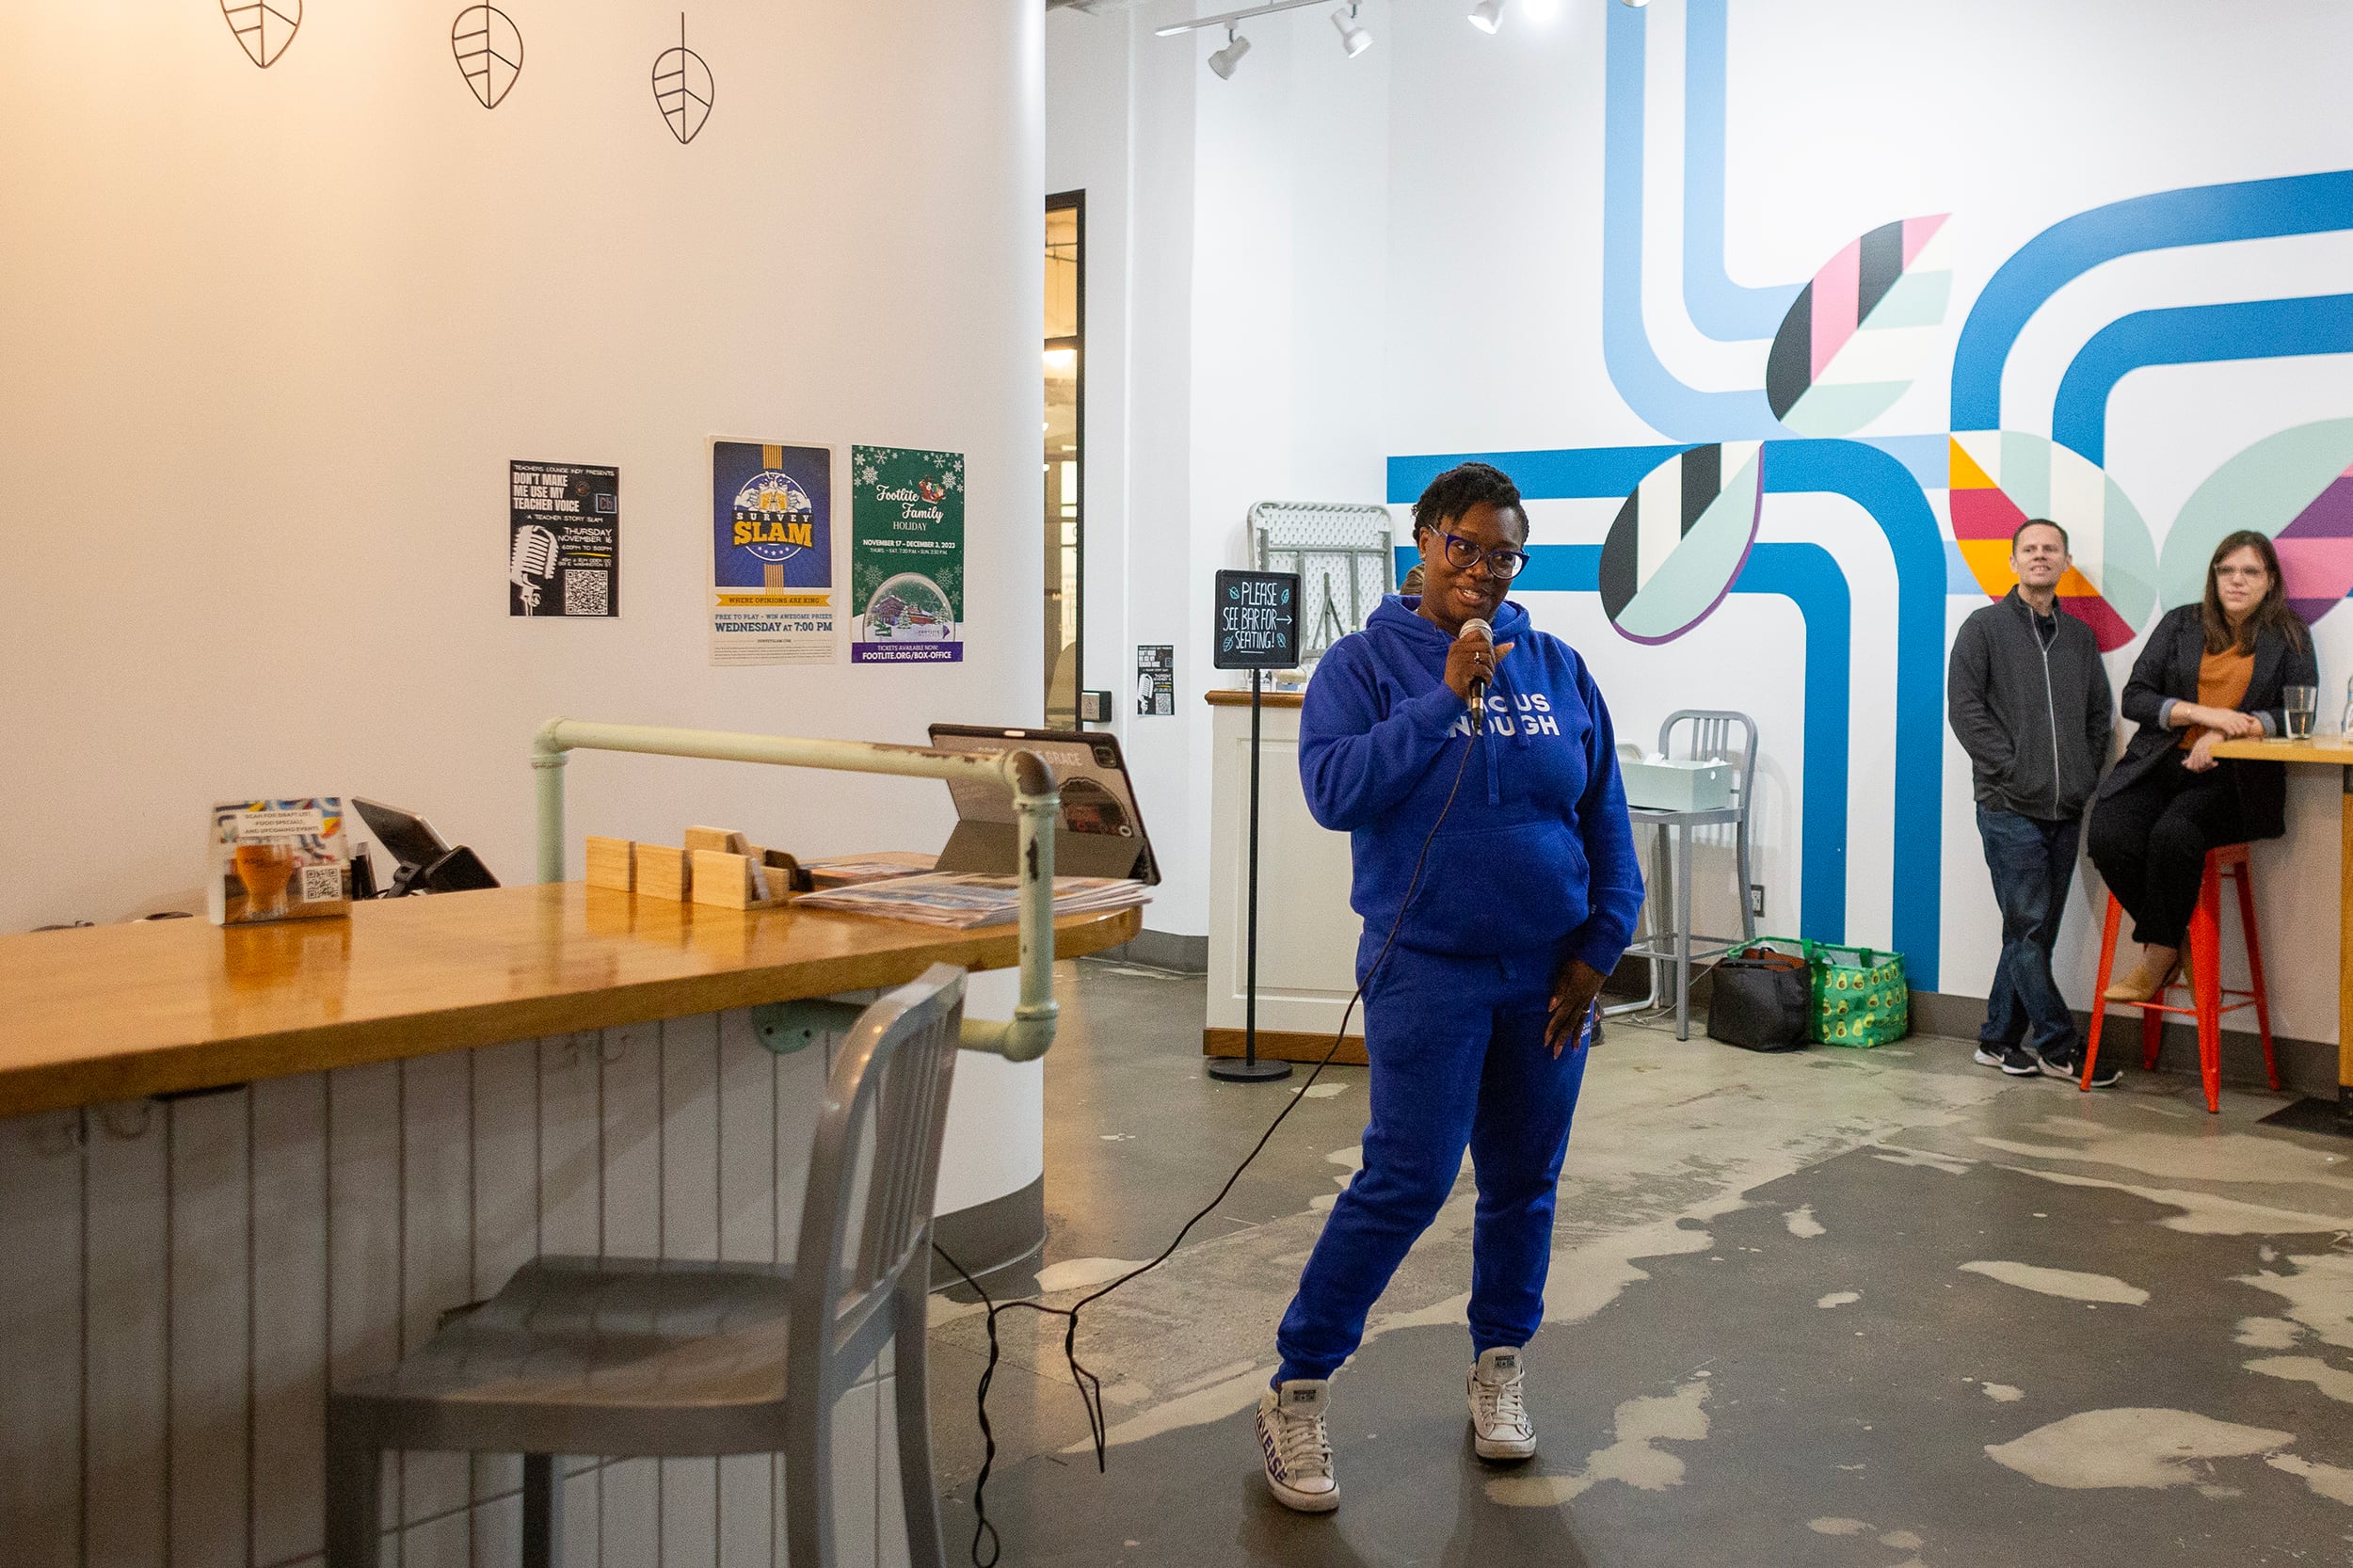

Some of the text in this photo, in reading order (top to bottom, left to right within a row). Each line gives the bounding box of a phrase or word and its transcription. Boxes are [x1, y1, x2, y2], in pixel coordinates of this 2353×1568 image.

[513, 472, 540, 485] DON'T
[542, 474, 568, 488] MAKE
[514, 485, 528, 497] ME
[530, 486, 548, 498] USE
[550, 488, 565, 500] MY
[876, 484, 920, 502] Footlite
[513, 498, 580, 513] TEACHER VOICE
[902, 502, 944, 523] Family
[736, 512, 809, 522] SURVEY
[564, 526, 612, 536] THURSDAY
[893, 521, 927, 531] HOLIDAY
[733, 520, 813, 548] SLAM
[1241, 581, 1277, 605] PLEASE
[1223, 606, 1277, 632] SEE BAR FOR
[715, 622, 781, 632] WEDNESDAY
[793, 622, 814, 632] 7:00
[817, 622, 833, 632] PM
[1235, 631, 1275, 649] SEATING!
[862, 651, 952, 661] FOOTLITE.ORG/BOX-OFFICE
